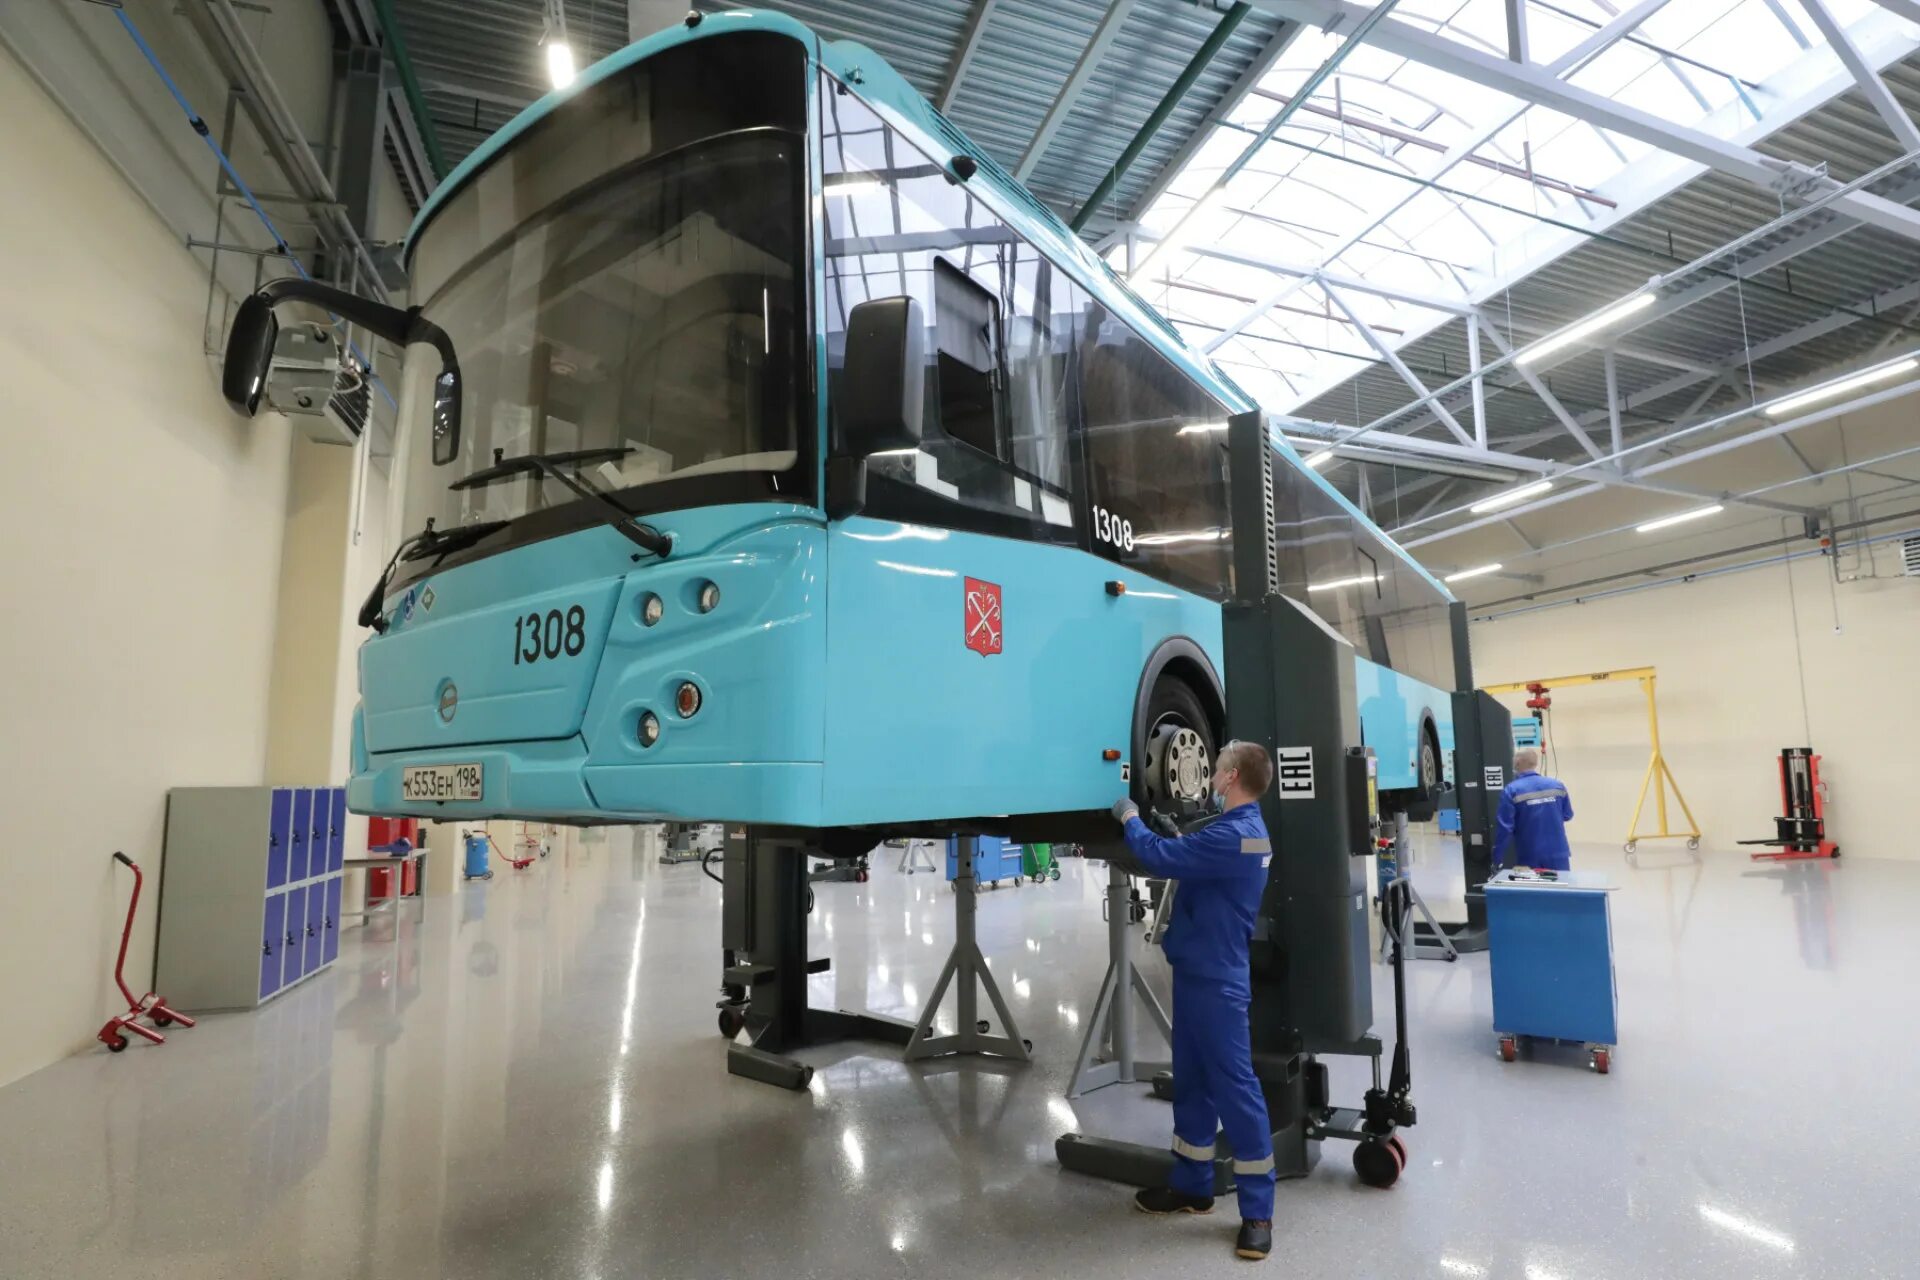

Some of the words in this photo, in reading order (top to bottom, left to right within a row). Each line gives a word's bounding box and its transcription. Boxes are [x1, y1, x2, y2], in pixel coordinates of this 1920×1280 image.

[1092, 504, 1134, 552] 1308
[514, 604, 586, 665] 1308
[456, 767, 477, 788] 198
[1280, 752, 1313, 792] EAC
